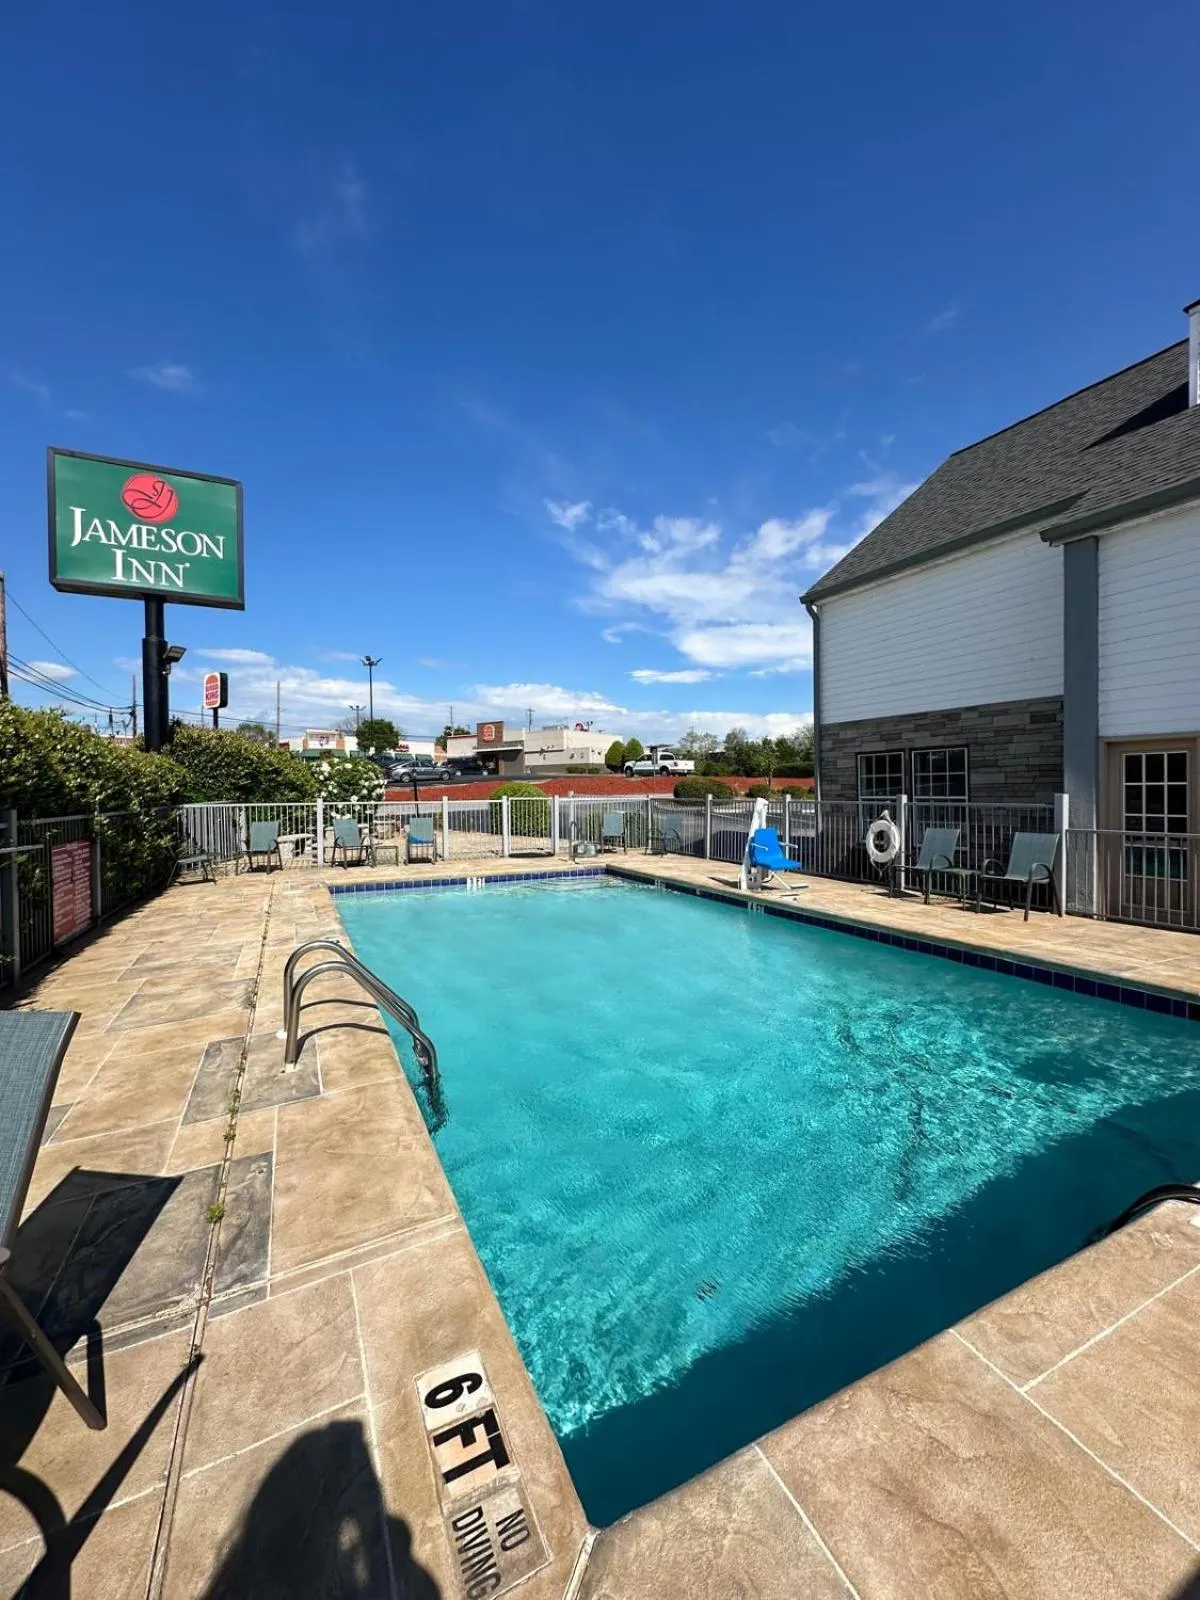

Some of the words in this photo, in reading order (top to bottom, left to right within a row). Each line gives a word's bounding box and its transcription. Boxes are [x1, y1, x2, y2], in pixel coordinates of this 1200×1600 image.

[69, 506, 226, 560] JAMESON
[111, 549, 186, 588] INN
[424, 1372, 483, 1409] 6
[433, 1409, 510, 1485] FT
[452, 1506, 502, 1600] DIVING
[496, 1509, 532, 1551] NO
